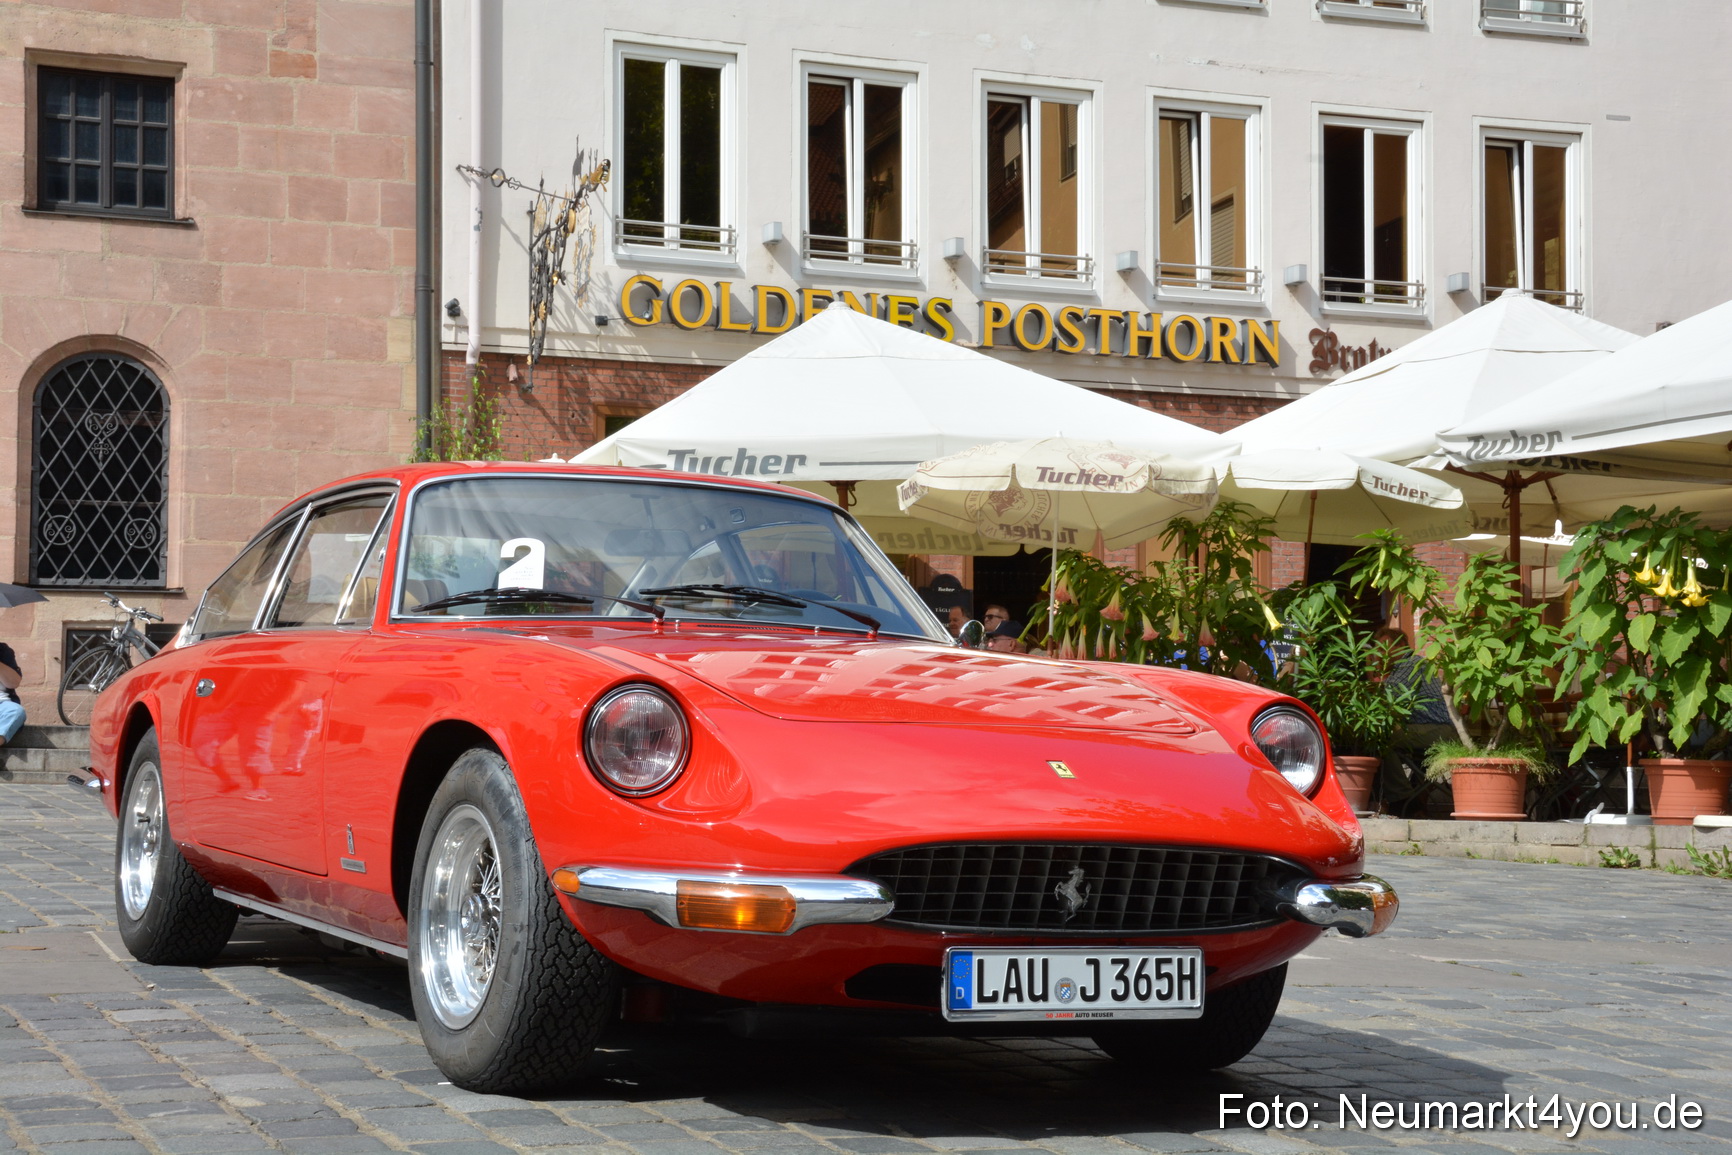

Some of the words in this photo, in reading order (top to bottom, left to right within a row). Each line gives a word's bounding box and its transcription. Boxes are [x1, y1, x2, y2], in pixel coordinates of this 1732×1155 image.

[977, 300, 1282, 367] POSTHORN
[1466, 430, 1563, 461] Tucher
[667, 447, 807, 476] Tucher
[1036, 465, 1124, 487] Tucher
[1372, 475, 1429, 500] Tucher
[497, 537, 546, 590] 2
[955, 987, 965, 1000] D
[976, 957, 1049, 1004] LAU
[1079, 957, 1101, 1004] J
[1110, 957, 1196, 1003] 365H
